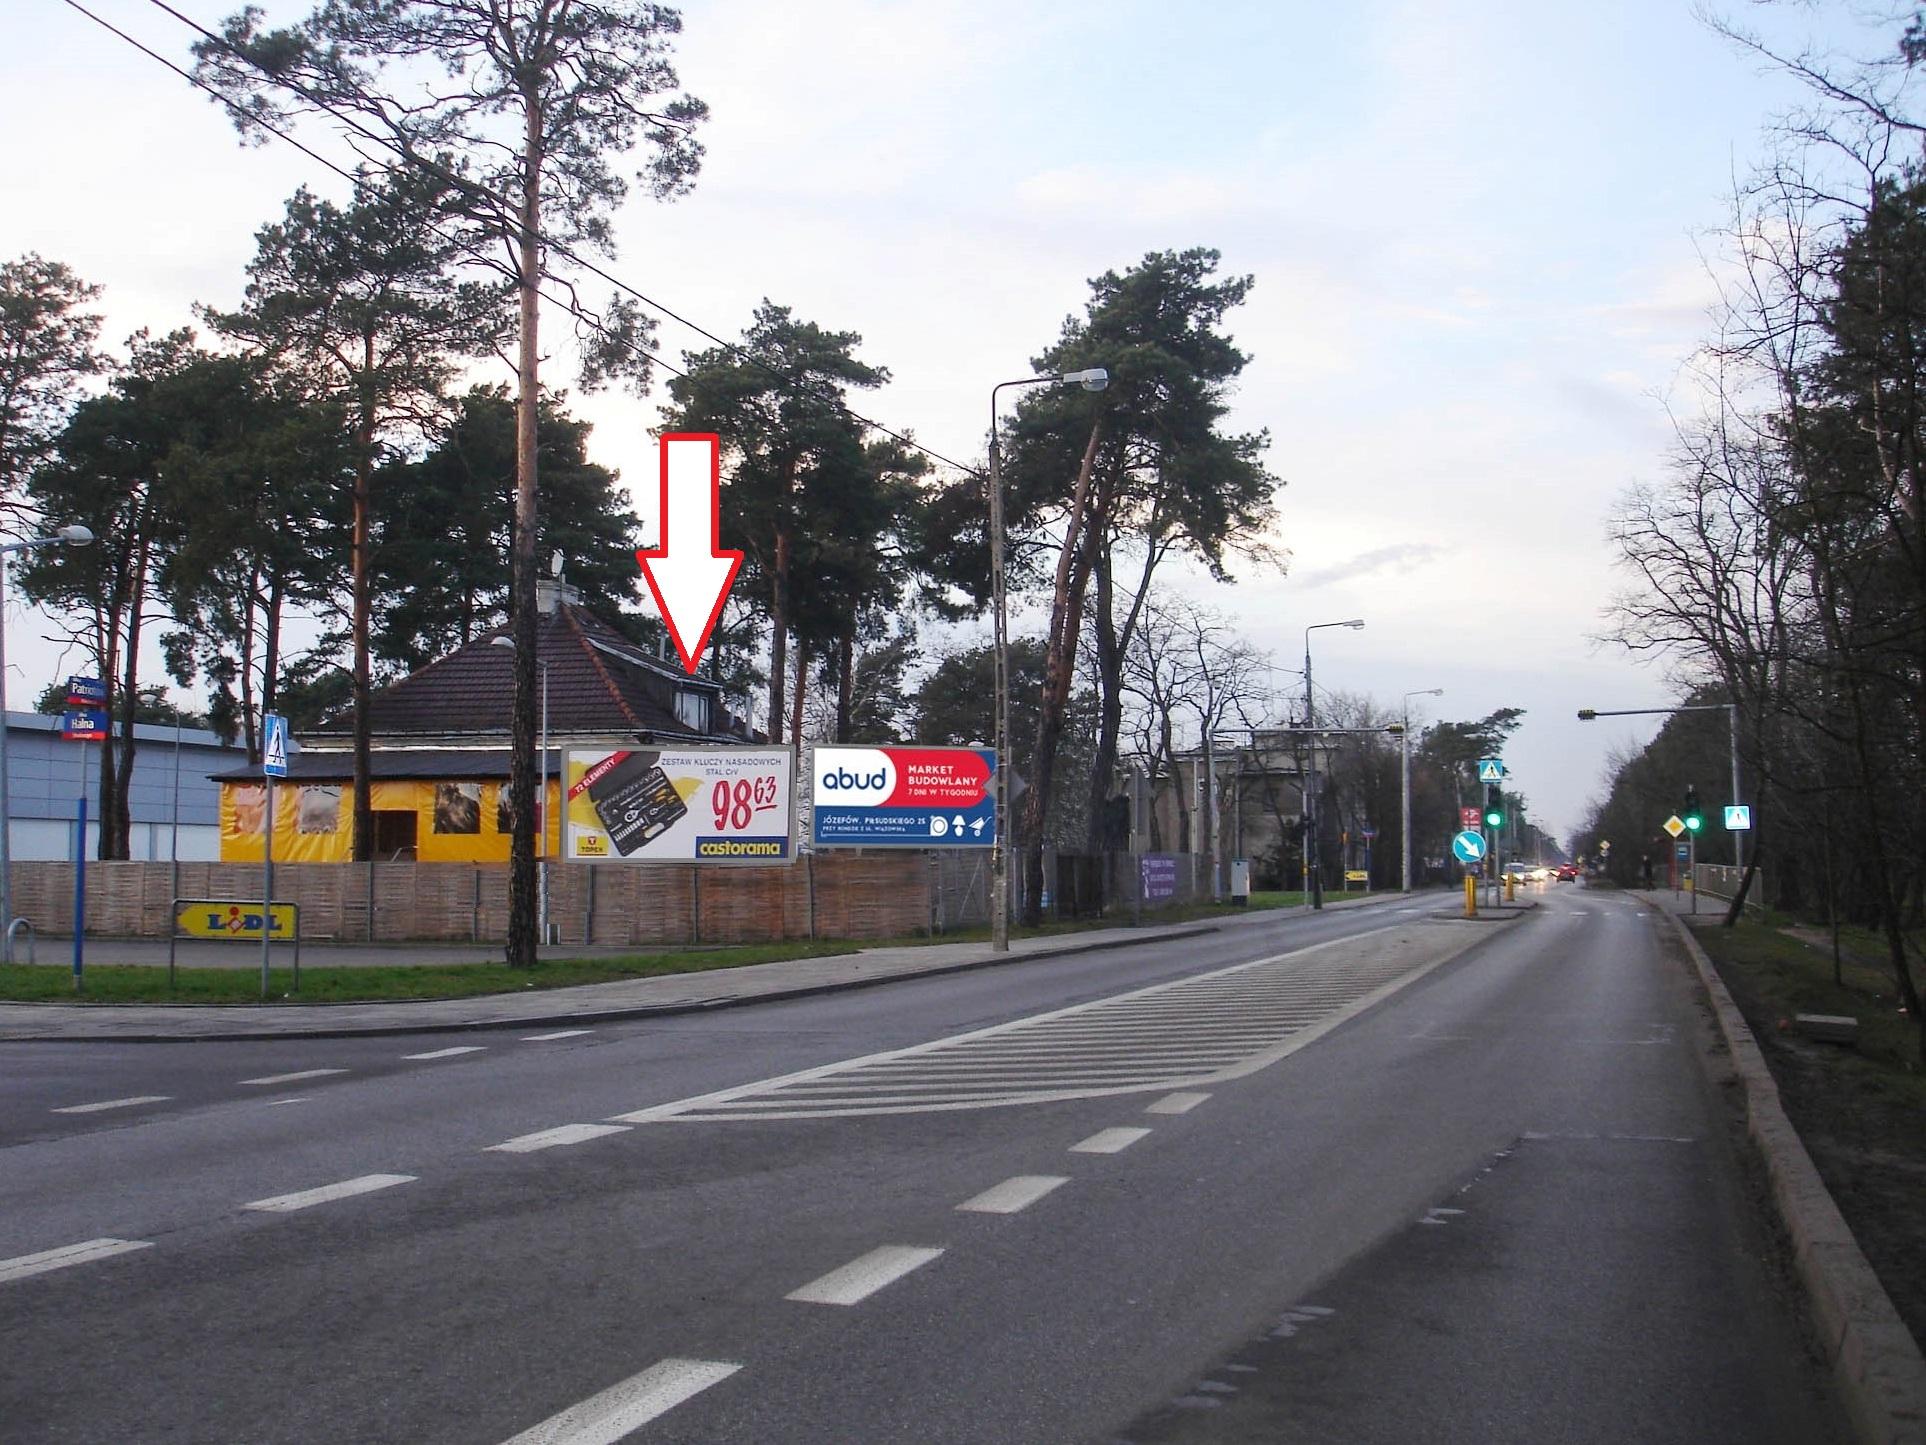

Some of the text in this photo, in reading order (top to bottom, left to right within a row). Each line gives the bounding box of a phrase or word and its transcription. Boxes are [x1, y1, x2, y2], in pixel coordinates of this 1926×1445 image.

[71, 717, 95, 729] Halna
[661, 758, 782, 766] ZESTAW KLUCZY NASADOWYCH
[583, 757, 616, 786] ELEMENTY
[705, 768, 723, 776] STAL
[908, 765, 954, 775] MARKET
[822, 767, 886, 790] abud
[908, 776, 977, 786] BUDOWLANY
[913, 788, 927, 796] DNI
[929, 788, 937, 796] W
[940, 788, 978, 797] TYGODNIU
[712, 776, 777, 831] 98 63
[699, 840, 781, 856] castorama
